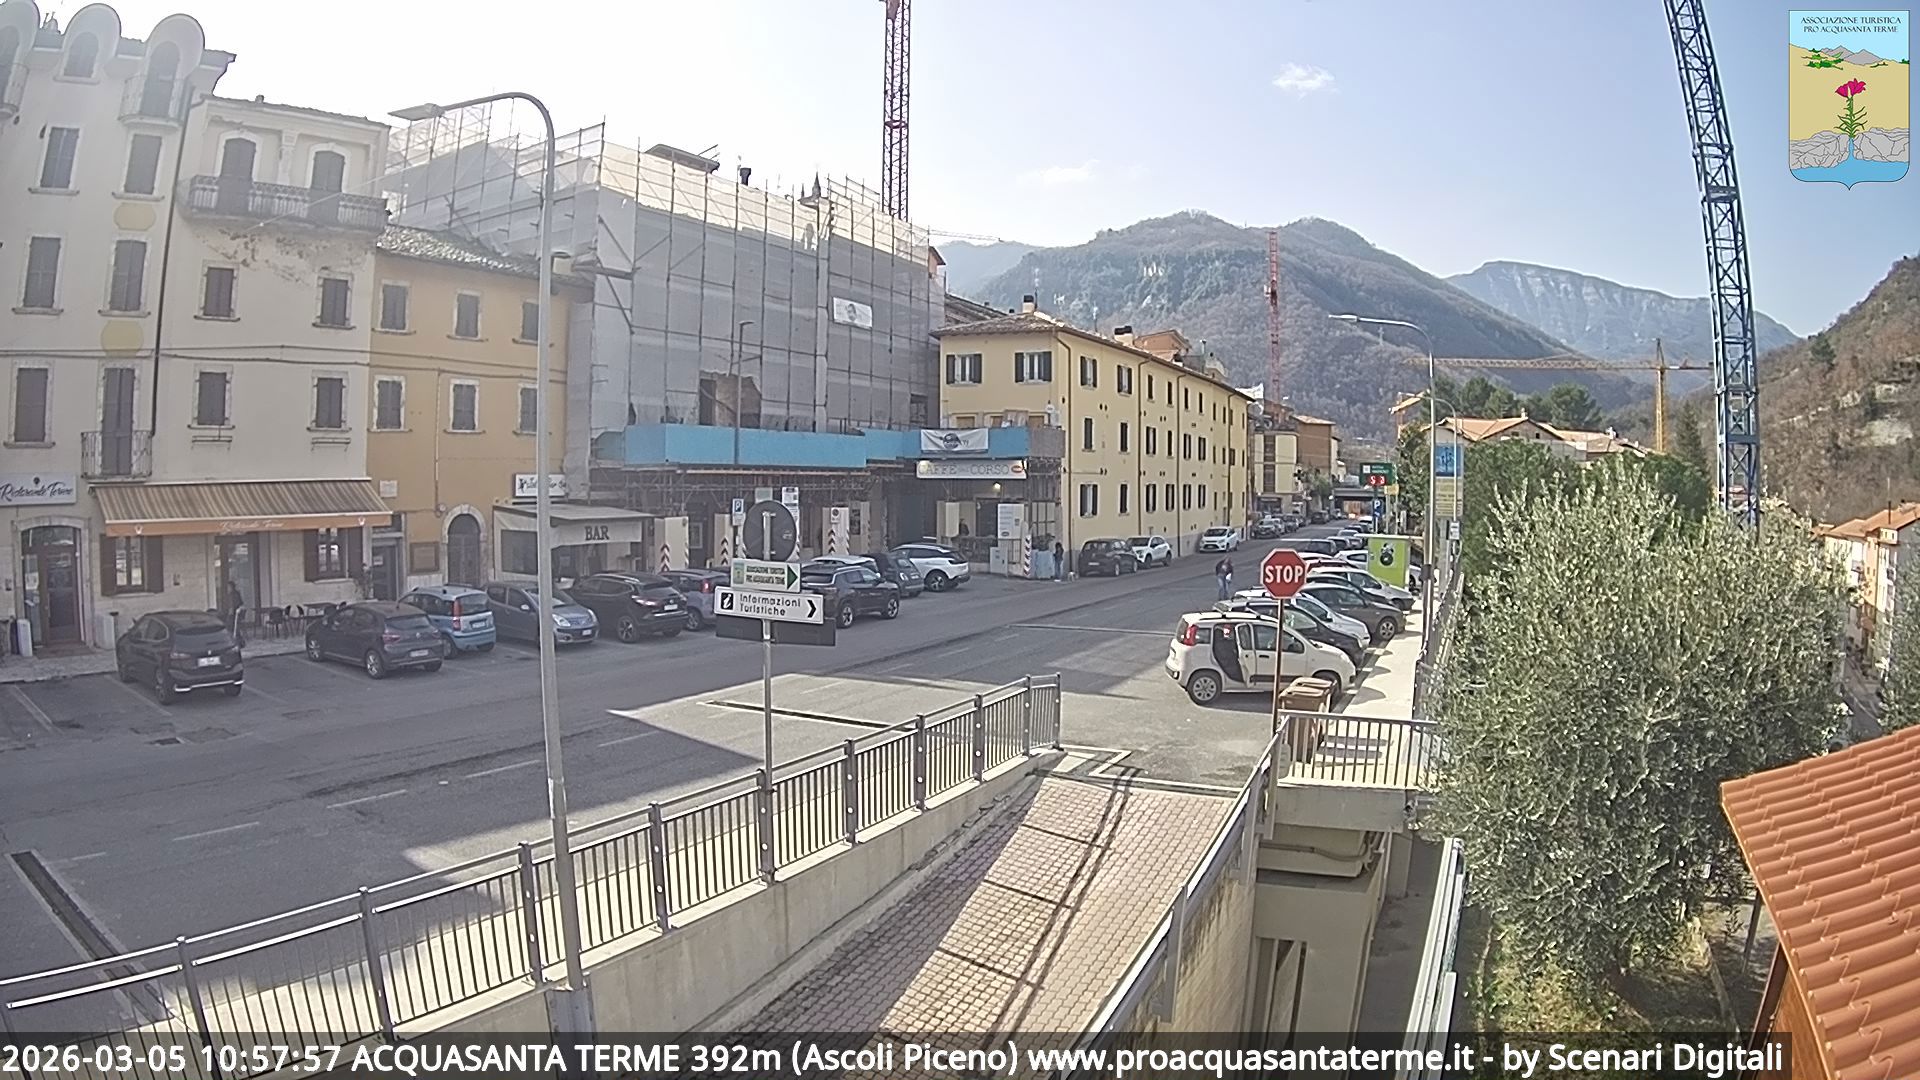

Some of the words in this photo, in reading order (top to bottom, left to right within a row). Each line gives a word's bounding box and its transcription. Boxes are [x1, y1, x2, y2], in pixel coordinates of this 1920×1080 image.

[970, 464, 1010, 475] CORSO
[584, 525, 610, 541] BAR
[1265, 565, 1304, 584] STOP
[740, 593, 801, 608] Informazioni
[740, 603, 786, 616] Turistiche
